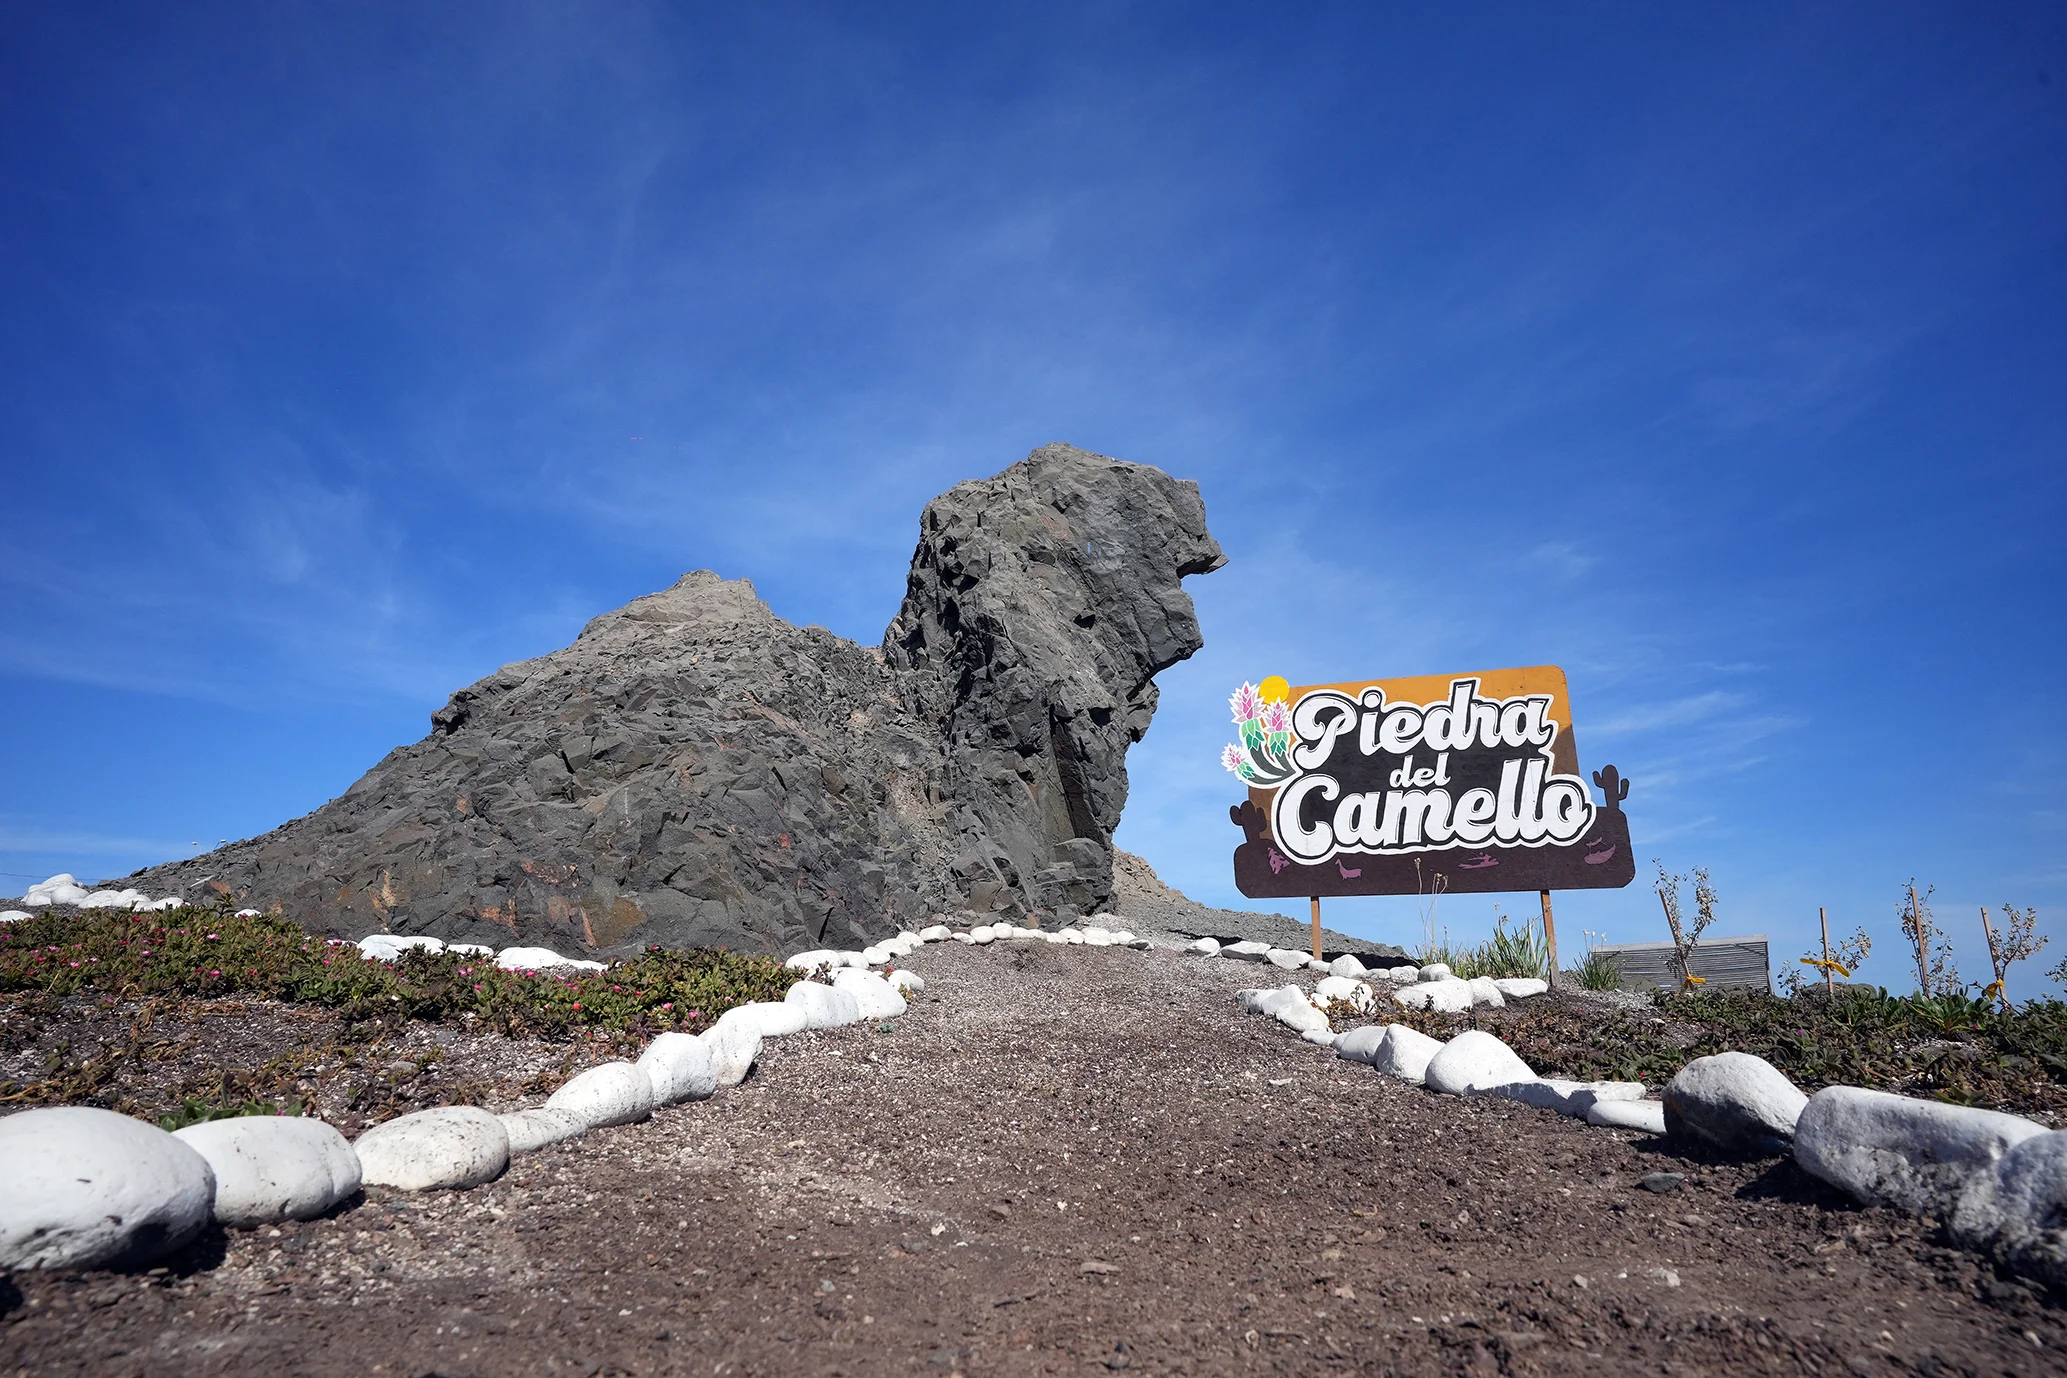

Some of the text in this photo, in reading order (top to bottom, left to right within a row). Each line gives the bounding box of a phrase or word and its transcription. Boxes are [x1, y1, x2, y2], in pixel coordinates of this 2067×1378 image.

[1294, 682, 1551, 769] Piedra
[1276, 757, 1591, 858] Camello
[1389, 752, 1451, 788] del
